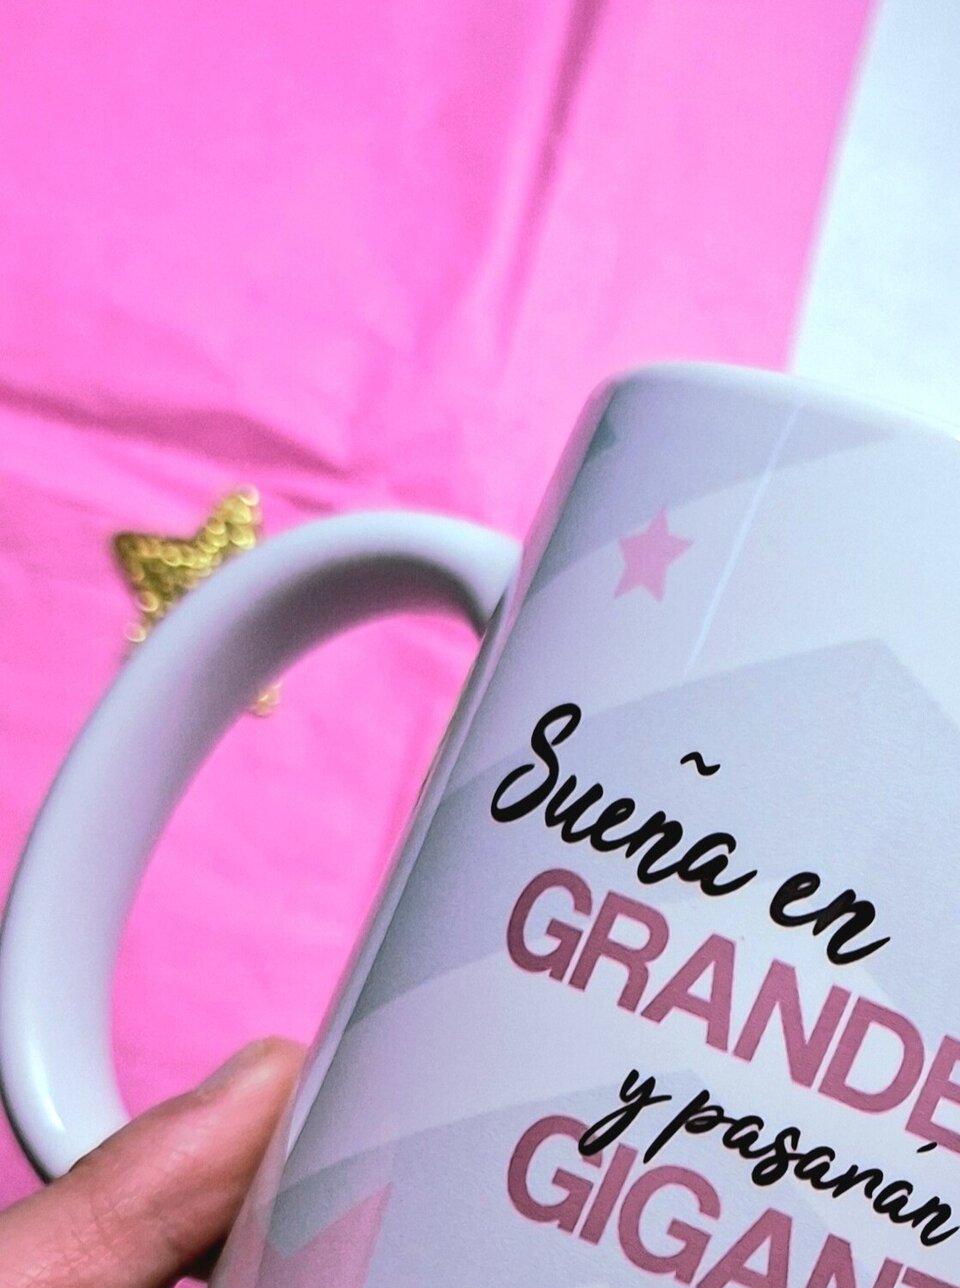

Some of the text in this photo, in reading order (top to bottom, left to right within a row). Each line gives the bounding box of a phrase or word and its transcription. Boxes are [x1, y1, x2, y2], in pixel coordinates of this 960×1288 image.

[491, 703, 891, 964] Sueña en
[578, 1069, 671, 1156] y
[644, 1089, 960, 1245] pasarán
